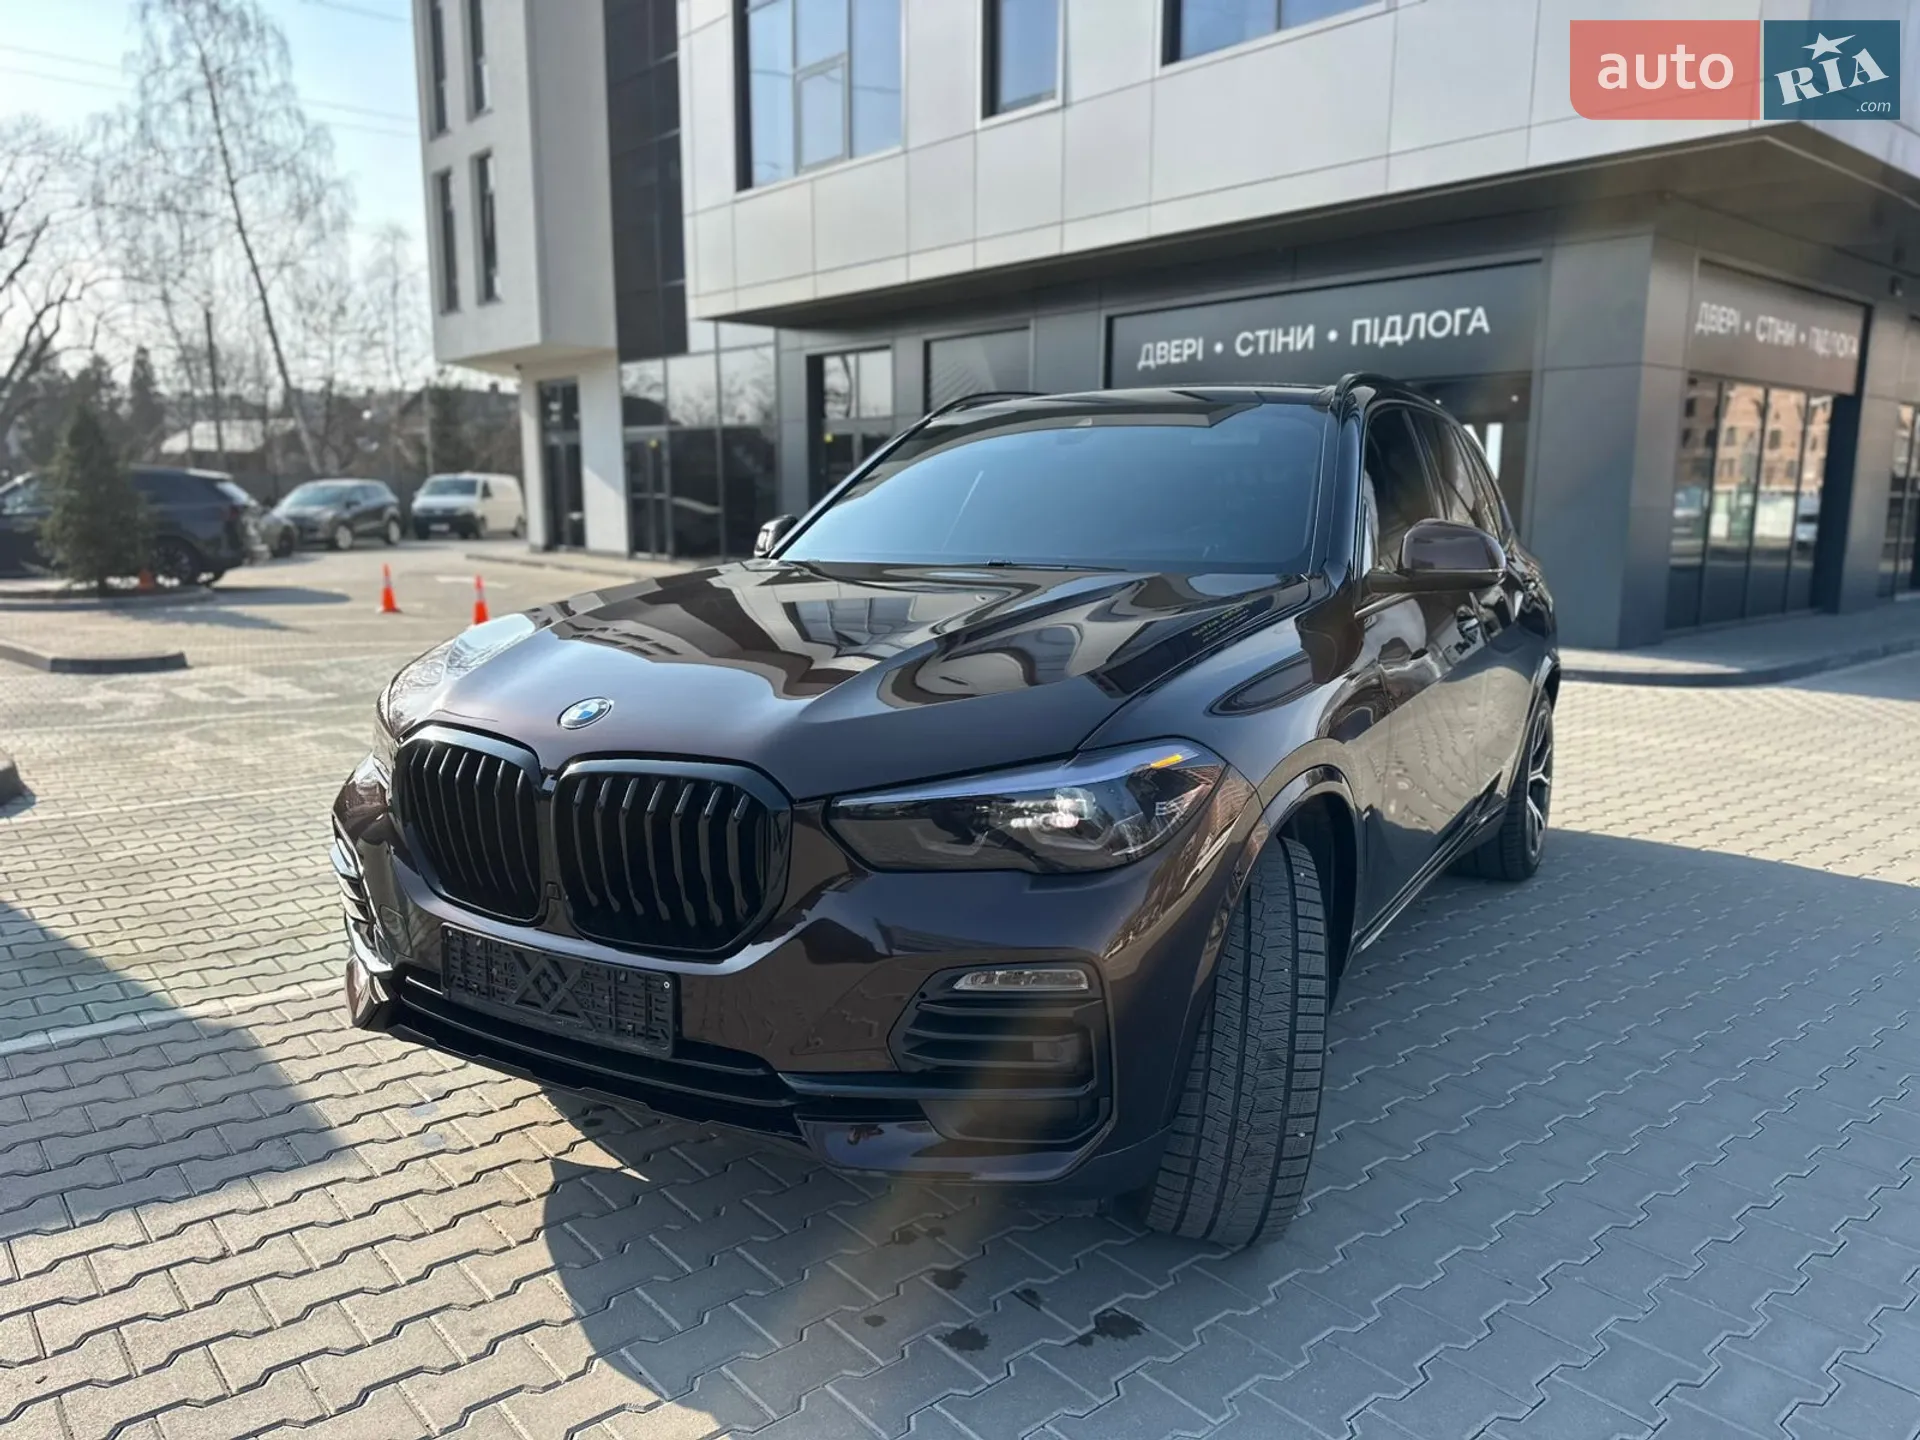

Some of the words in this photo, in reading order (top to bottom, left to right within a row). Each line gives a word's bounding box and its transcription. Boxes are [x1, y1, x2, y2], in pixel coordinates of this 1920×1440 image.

[1137, 337, 1204, 371] ДВЕРІ
[1235, 324, 1316, 358] СТІНИ
[1350, 306, 1491, 348] ПІДЛОГА
[1695, 301, 1742, 337] ДВЕРІ
